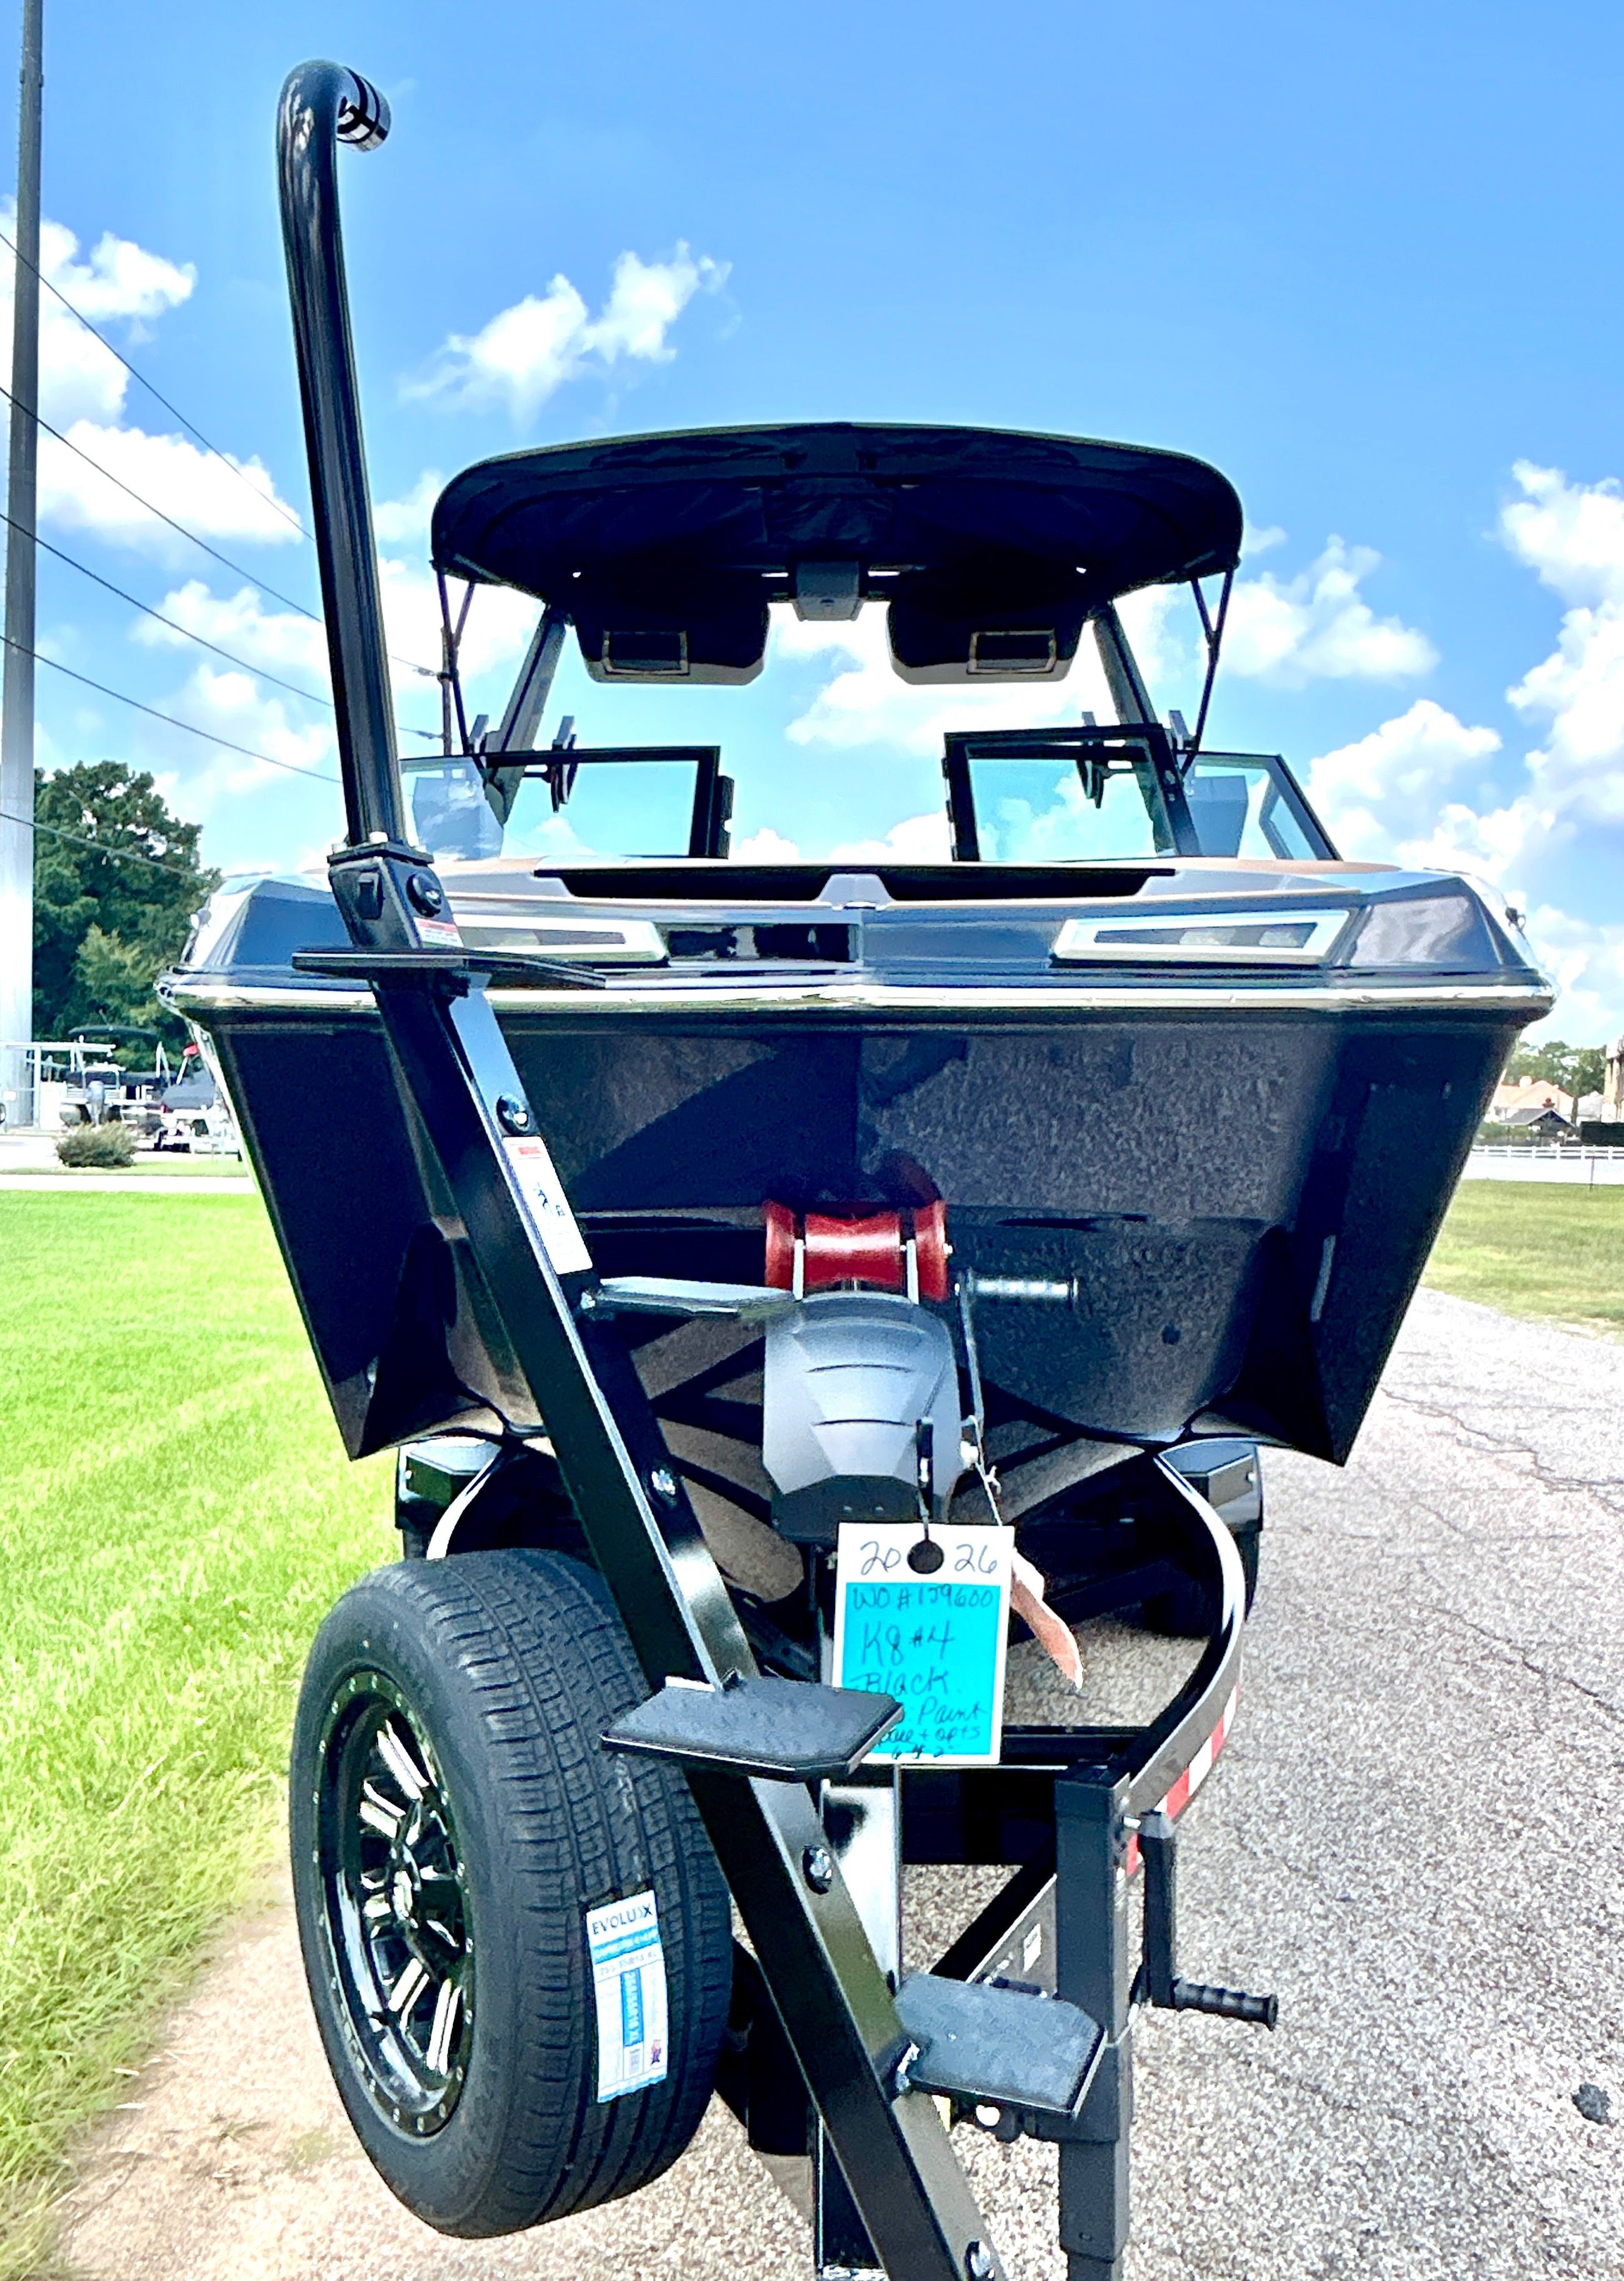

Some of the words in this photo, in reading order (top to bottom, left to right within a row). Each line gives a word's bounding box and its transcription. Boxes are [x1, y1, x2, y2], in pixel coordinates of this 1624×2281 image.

[860, 1540, 901, 1575] 20
[954, 1543, 998, 1574] 26
[850, 1666, 948, 1697] Black
